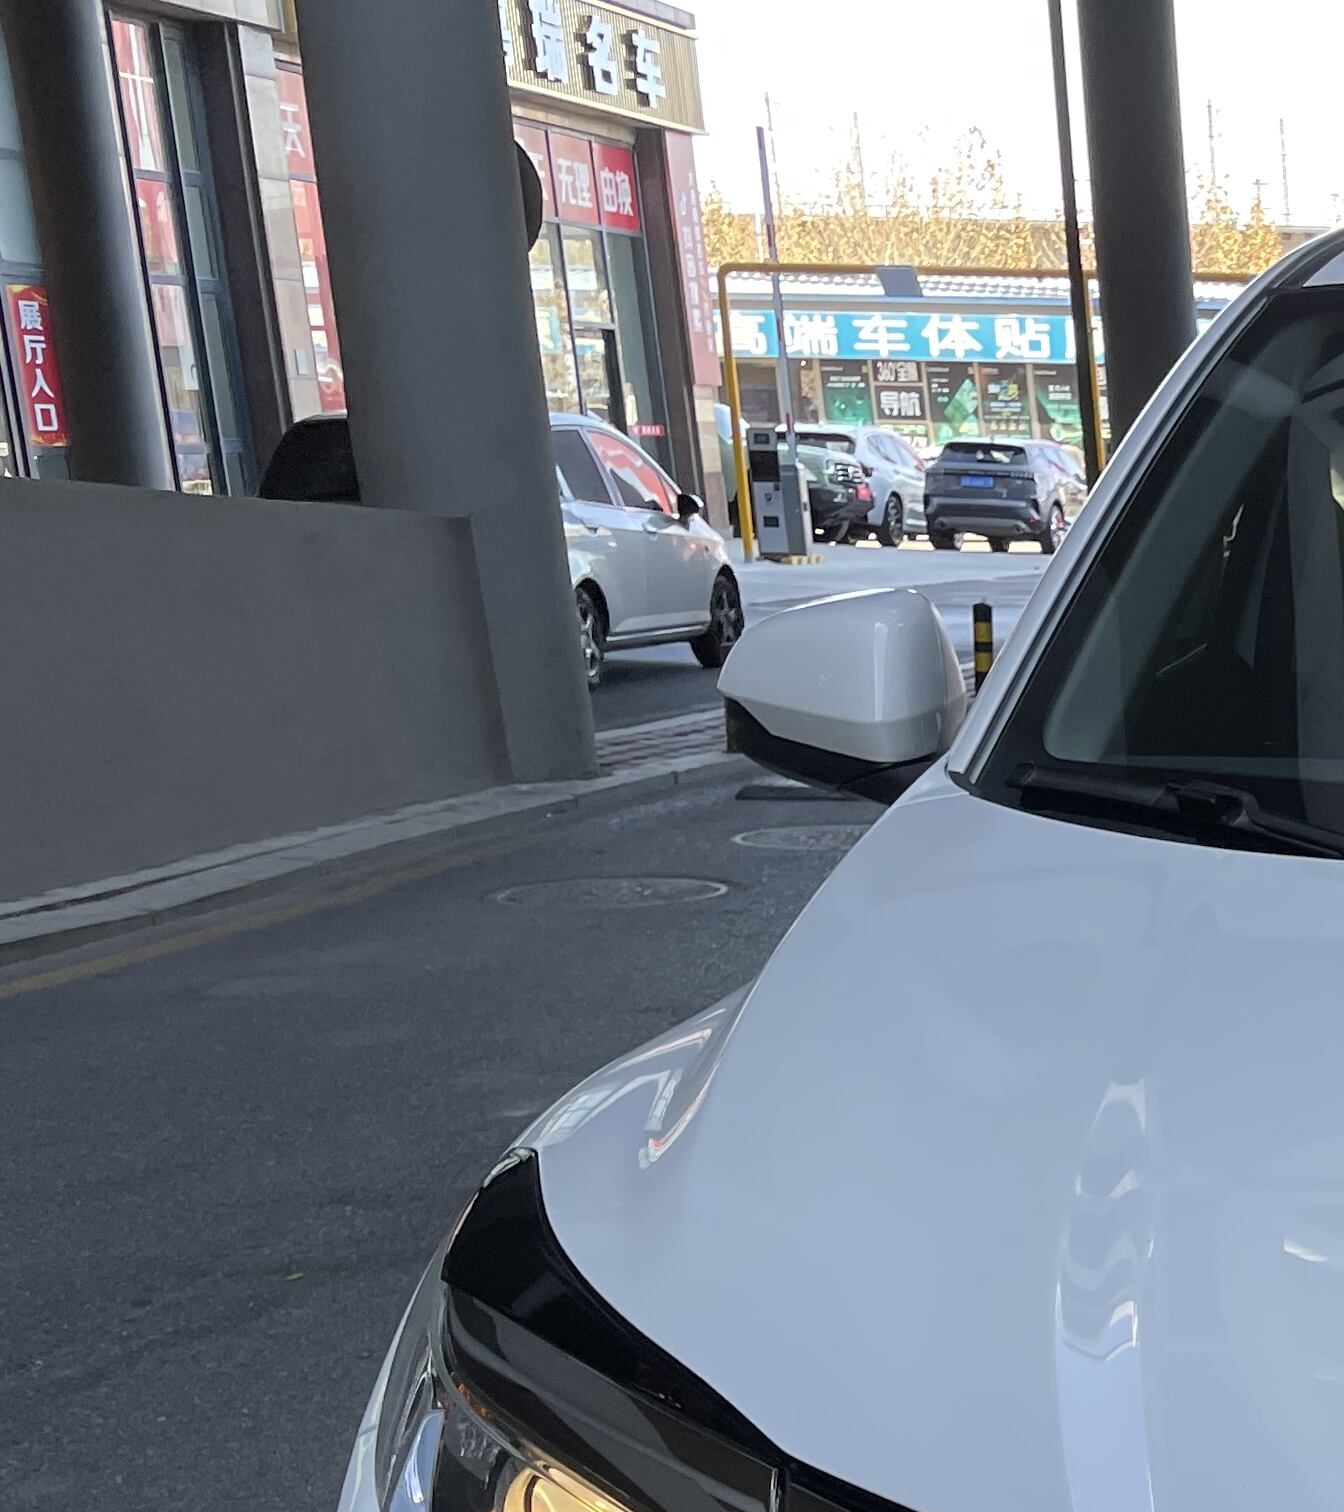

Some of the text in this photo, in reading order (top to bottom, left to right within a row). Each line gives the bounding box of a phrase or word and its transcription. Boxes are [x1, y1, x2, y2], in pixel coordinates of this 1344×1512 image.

[500, 0, 666, 108] 瑞名车
[514, 137, 633, 216] 无理由换
[18, 300, 58, 431] 展厅入口
[880, 391, 921, 416] 导航
